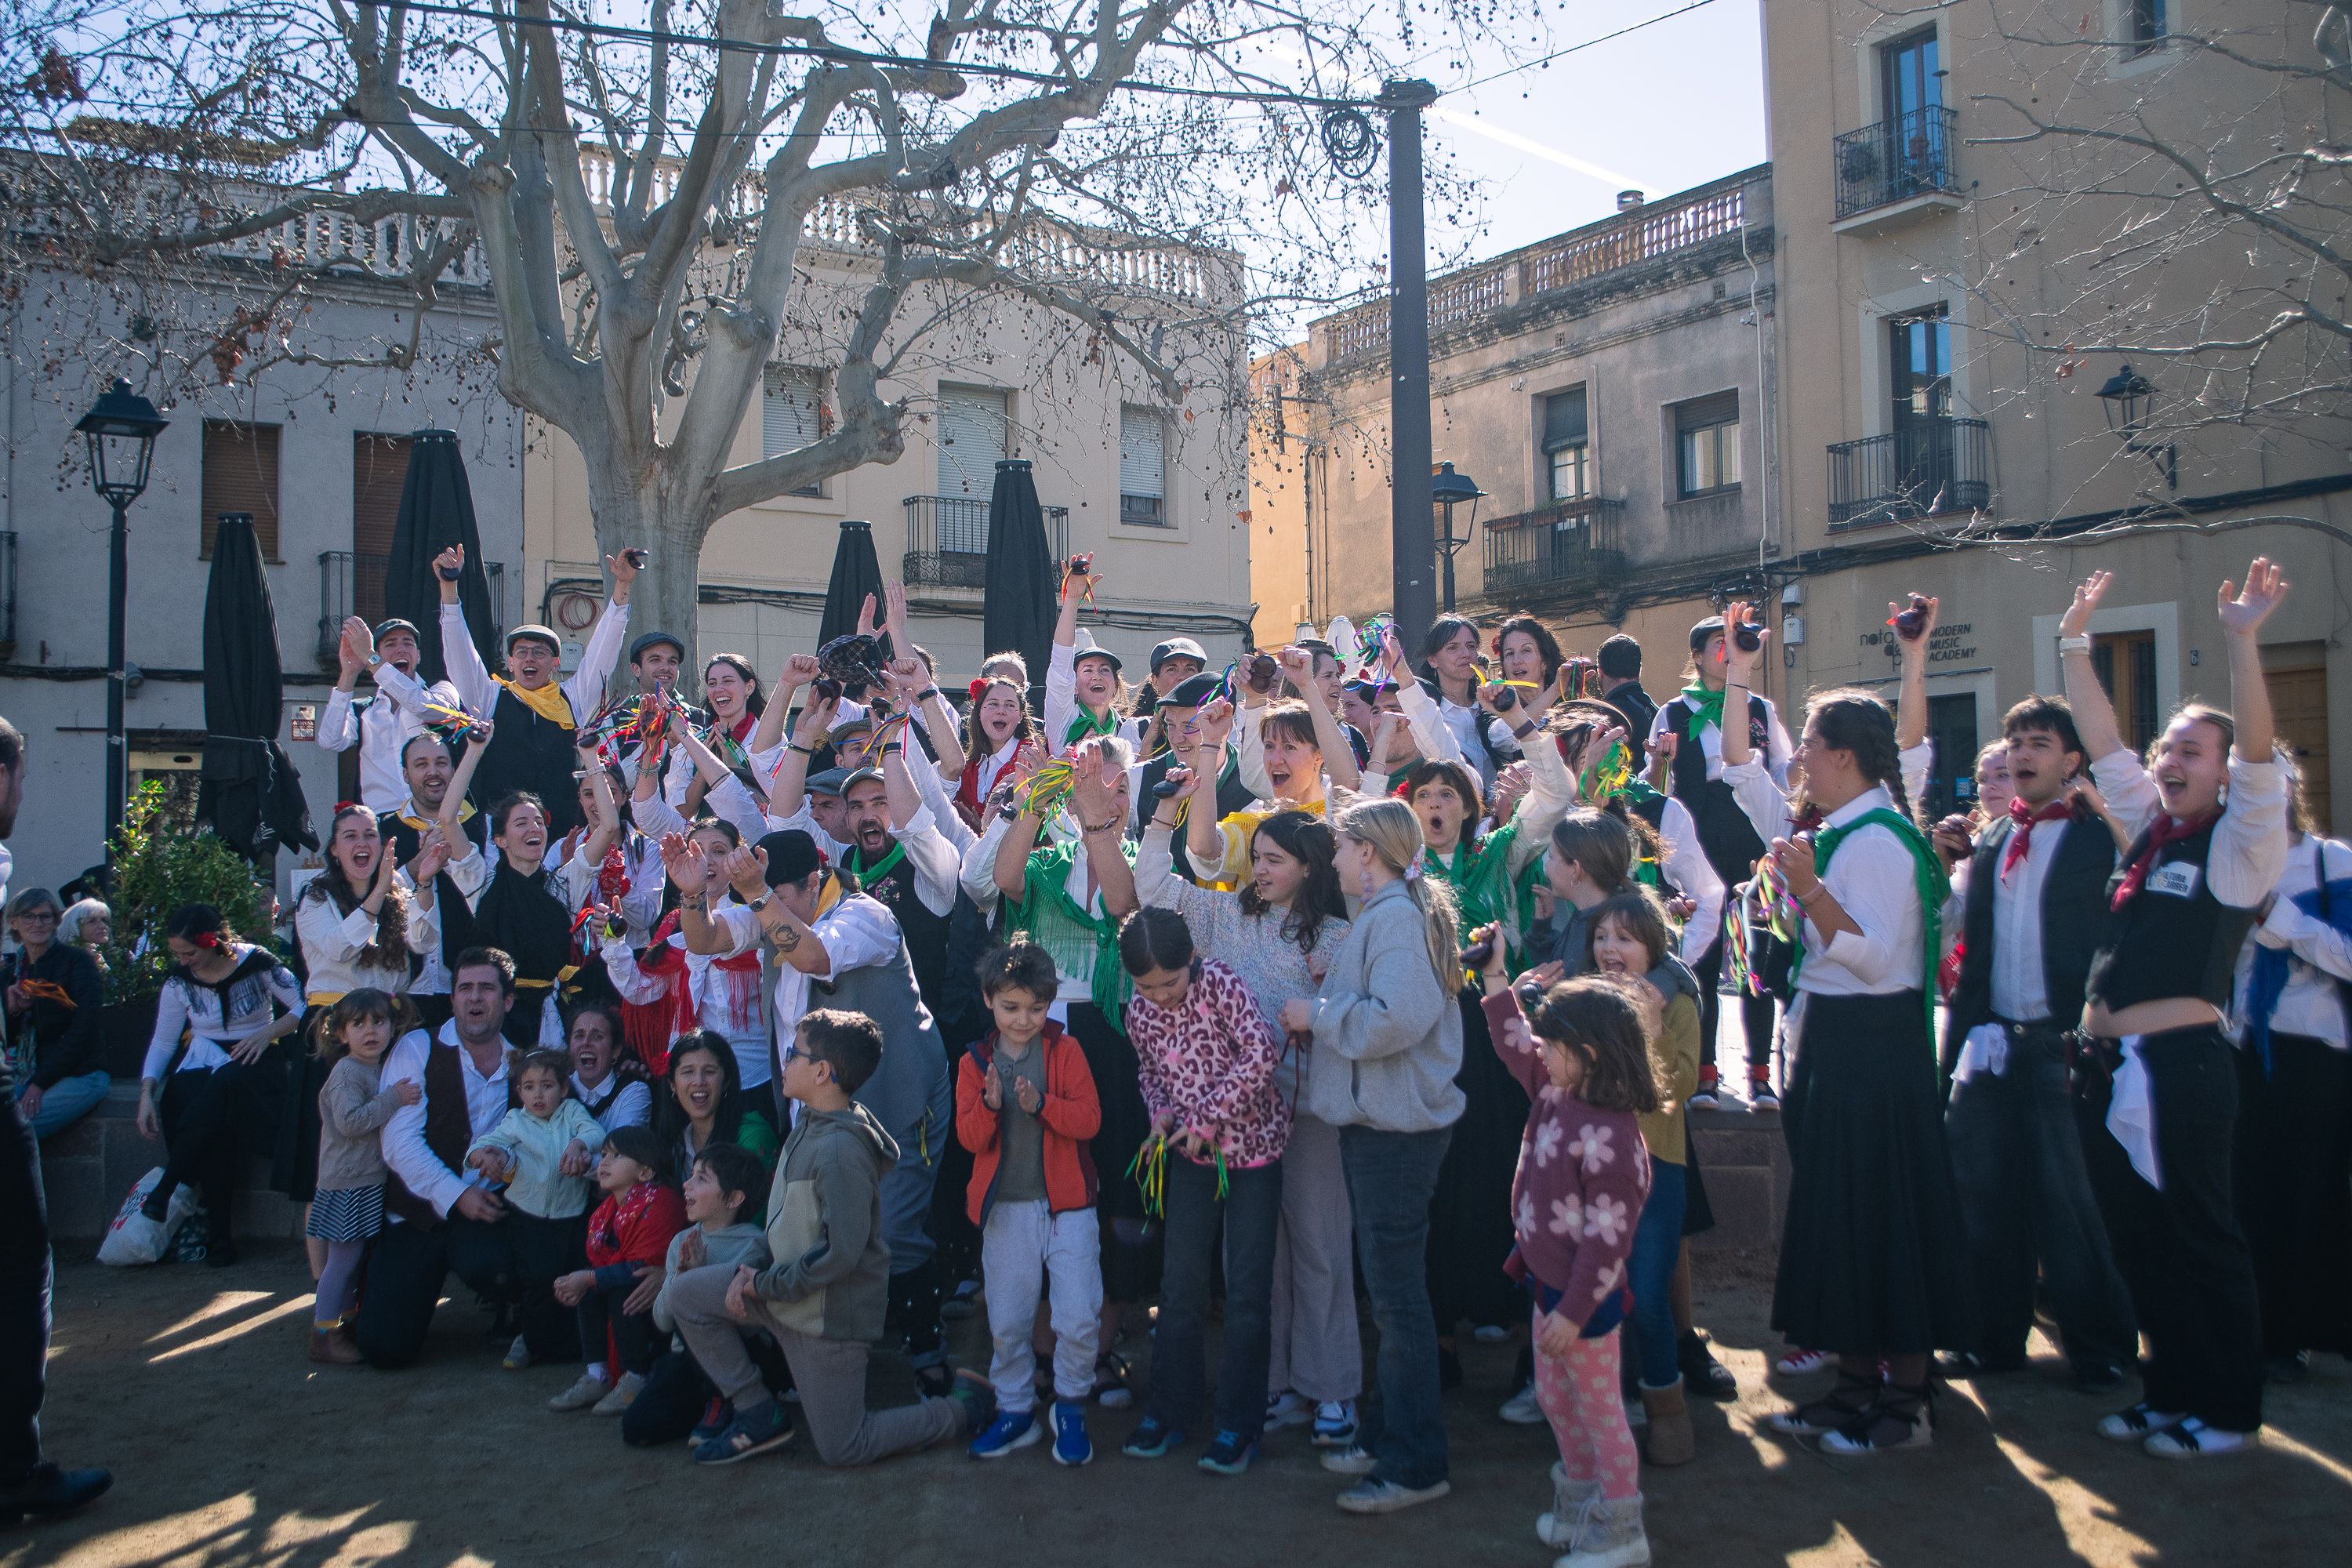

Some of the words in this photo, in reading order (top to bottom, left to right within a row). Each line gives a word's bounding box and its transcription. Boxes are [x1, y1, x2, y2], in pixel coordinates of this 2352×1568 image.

[1929, 623, 1971, 637] MODERN
[1929, 637, 1960, 651] MUSIC
[1928, 647, 1976, 662] ACADEMY
